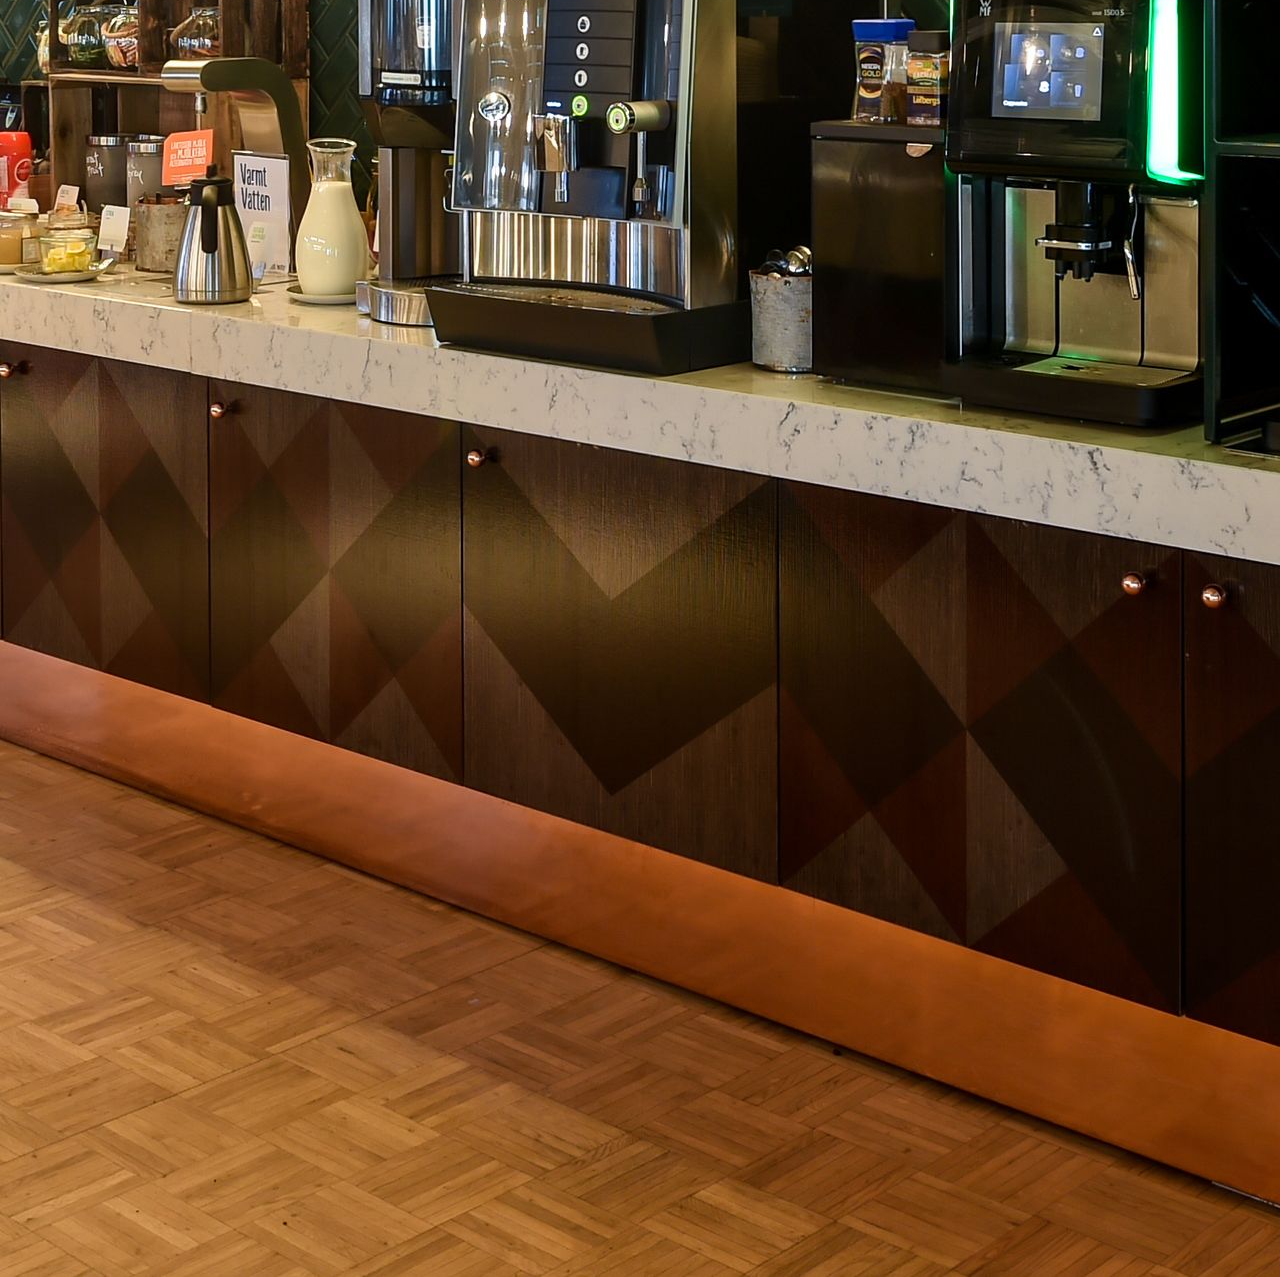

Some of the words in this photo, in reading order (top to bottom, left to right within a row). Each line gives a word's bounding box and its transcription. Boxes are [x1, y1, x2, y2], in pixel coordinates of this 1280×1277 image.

[862, 69, 881, 77] GOLD
[240, 163, 268, 187] Varmt
[241, 187, 271, 211] Vatten
